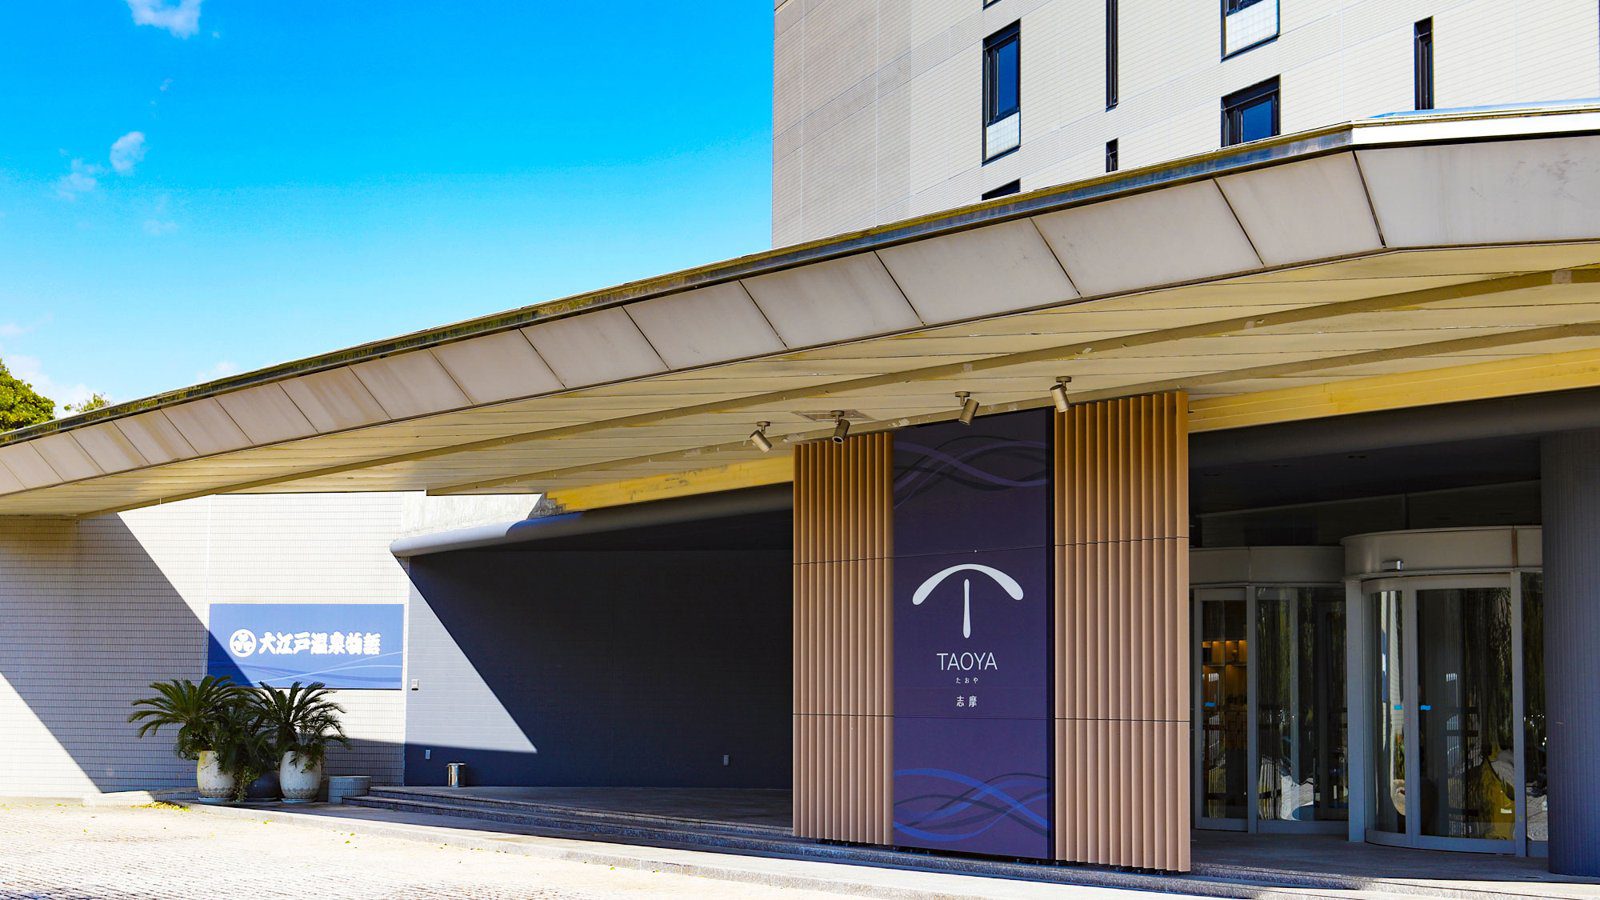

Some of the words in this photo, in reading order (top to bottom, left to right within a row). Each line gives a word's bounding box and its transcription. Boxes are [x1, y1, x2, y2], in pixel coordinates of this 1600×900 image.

[258, 631, 381, 655] 大江戸温泉物語
[936, 652, 998, 671] TAOYA
[956, 695, 978, 708] 志摩
